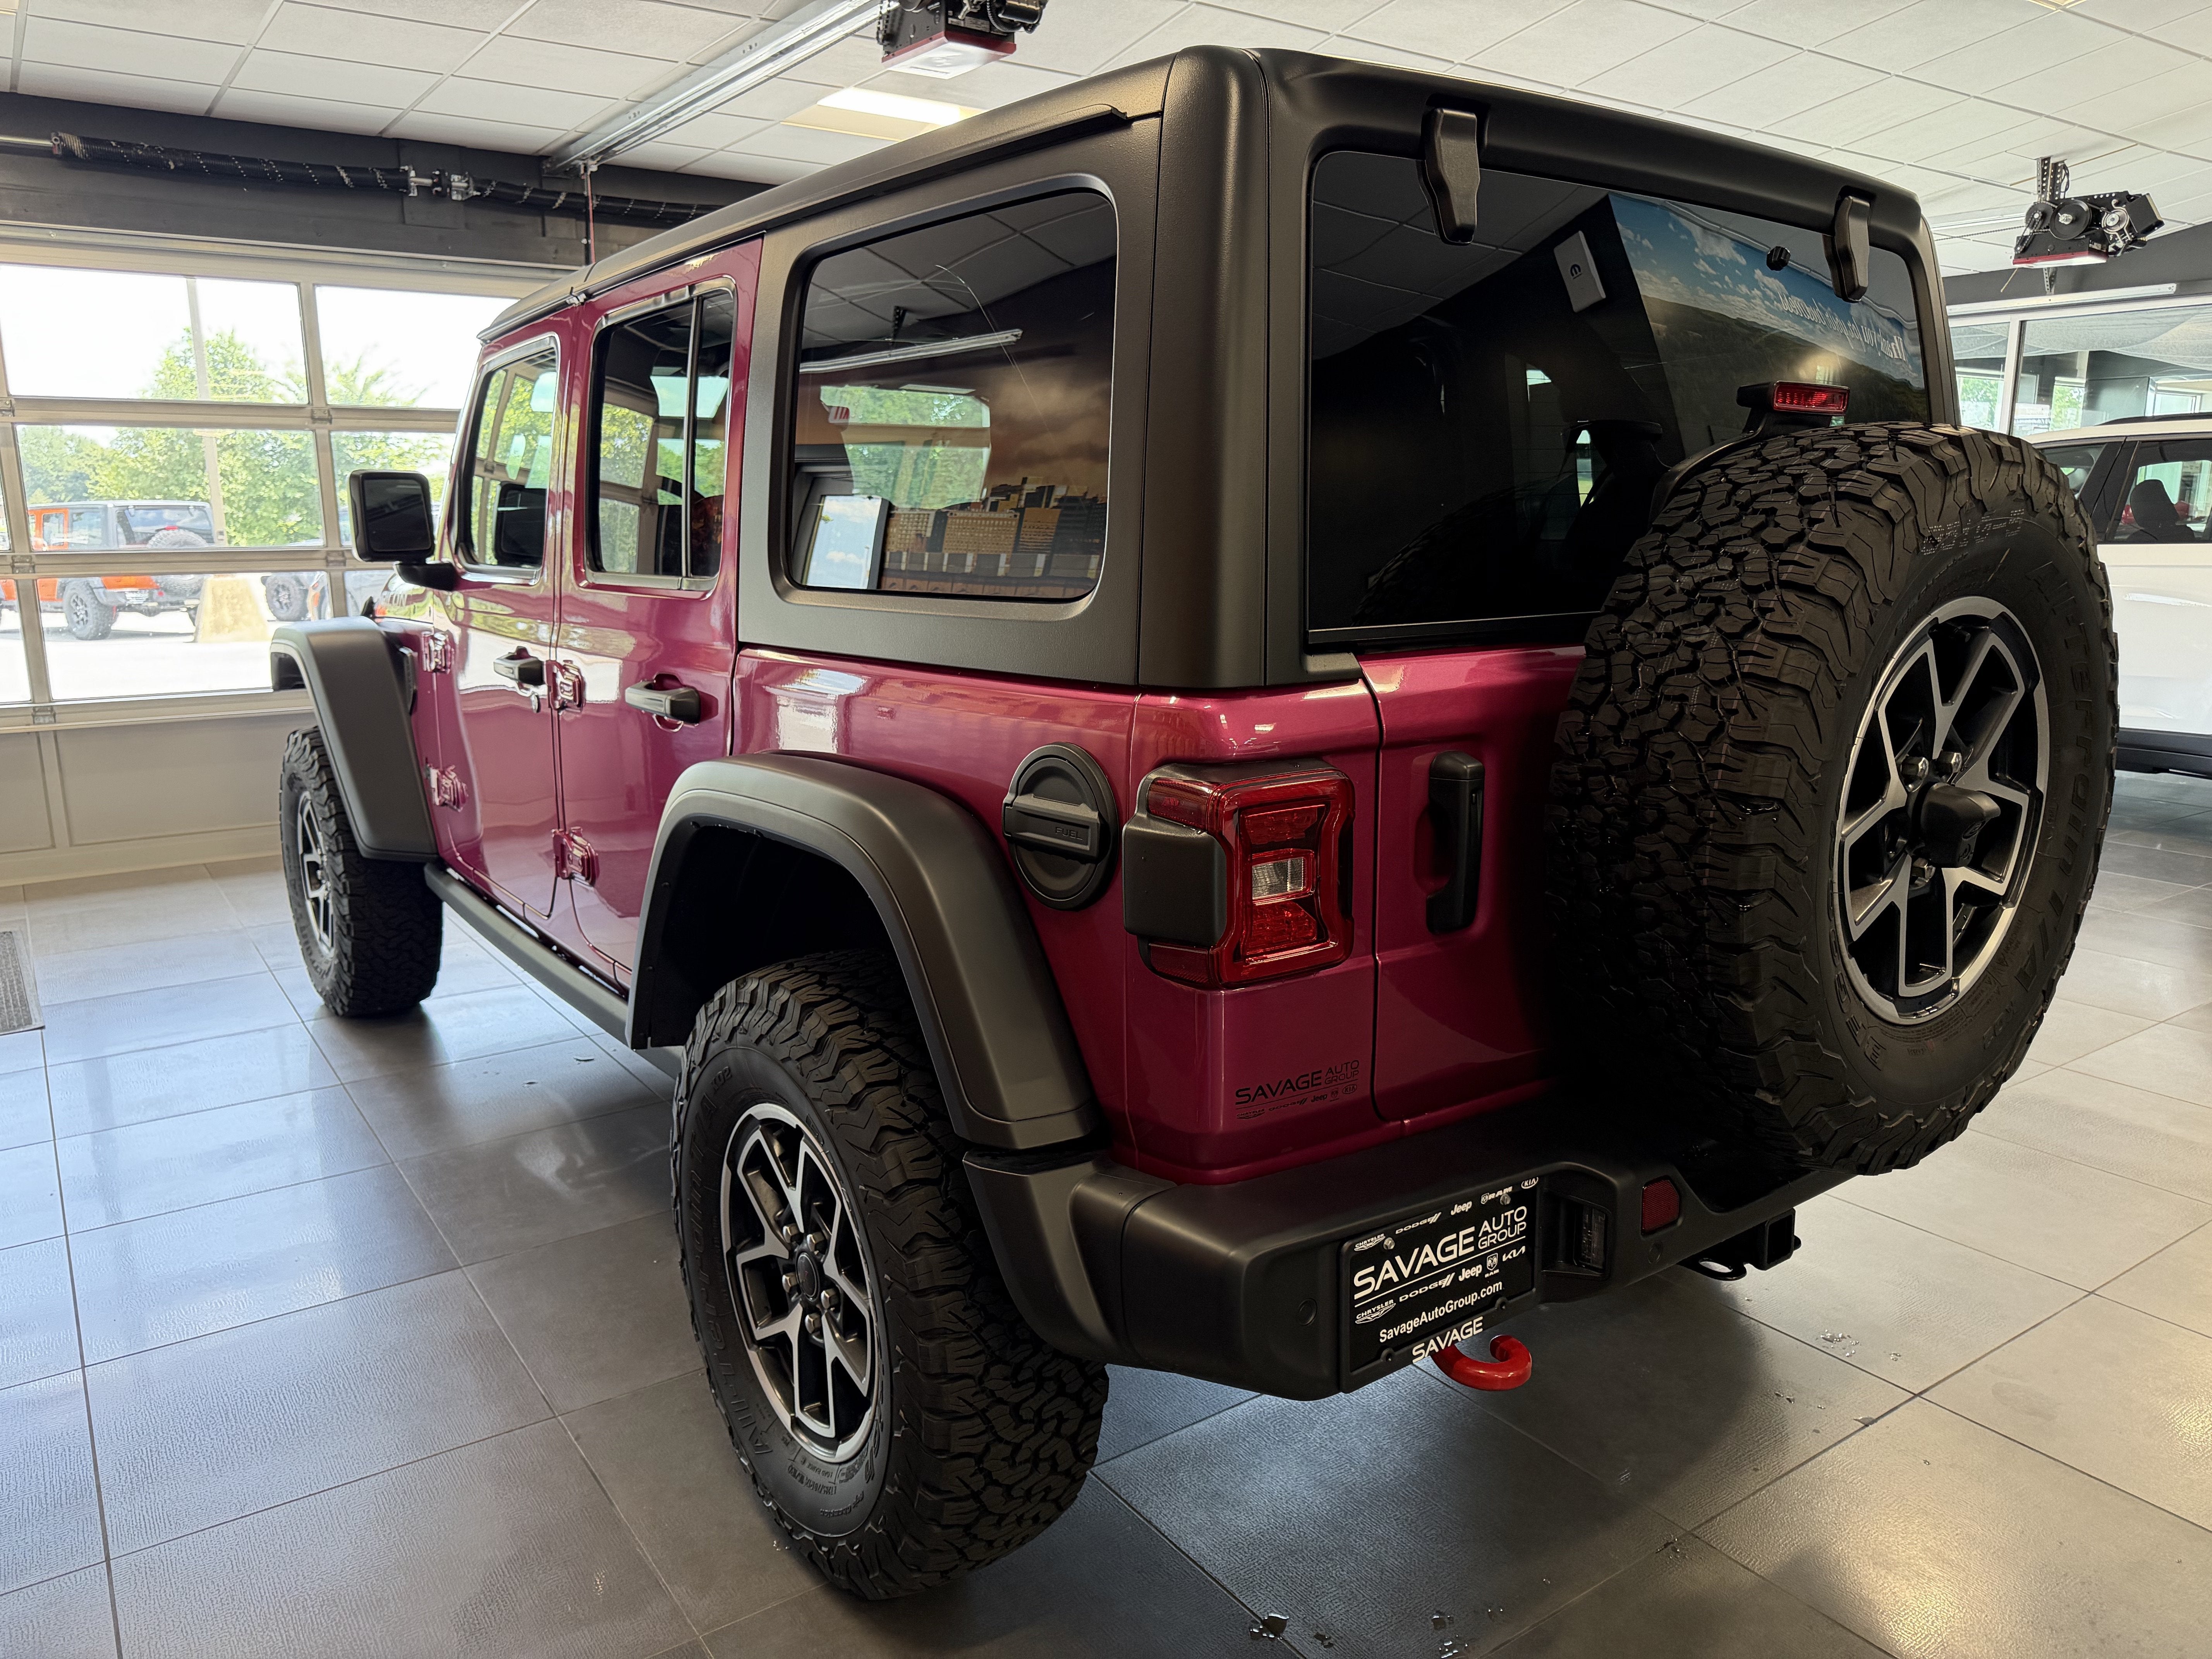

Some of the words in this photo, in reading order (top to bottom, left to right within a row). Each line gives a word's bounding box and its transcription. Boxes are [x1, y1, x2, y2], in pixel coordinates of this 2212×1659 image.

[1055, 827, 1083, 840] FUEL
[1235, 1070, 1322, 1105] SAVAGE
[1325, 1060, 1359, 1077] AUTO
[1311, 1093, 1328, 1103] Jeep
[1324, 1070, 1359, 1085] GROUP
[1355, 1233, 1385, 1247] CHRYSLER
[1395, 1217, 1433, 1235] DODGE
[1451, 1201, 1472, 1216] Jeep
[1488, 1186, 1513, 1200] RAM
[1478, 1221, 1527, 1250] GROUP
[1354, 1226, 1475, 1300] SAVAGE
[1479, 1206, 1527, 1237] AUTO
[1356, 1299, 1394, 1320] CHRYSLER
[1399, 1278, 1447, 1302] DODGE
[1458, 1264, 1482, 1282] Jeep
[1485, 1269, 1499, 1278] RAM
[1379, 1281, 1503, 1343] SavageAutoGroup.com
[1412, 1316, 1484, 1364] SAVAGE
